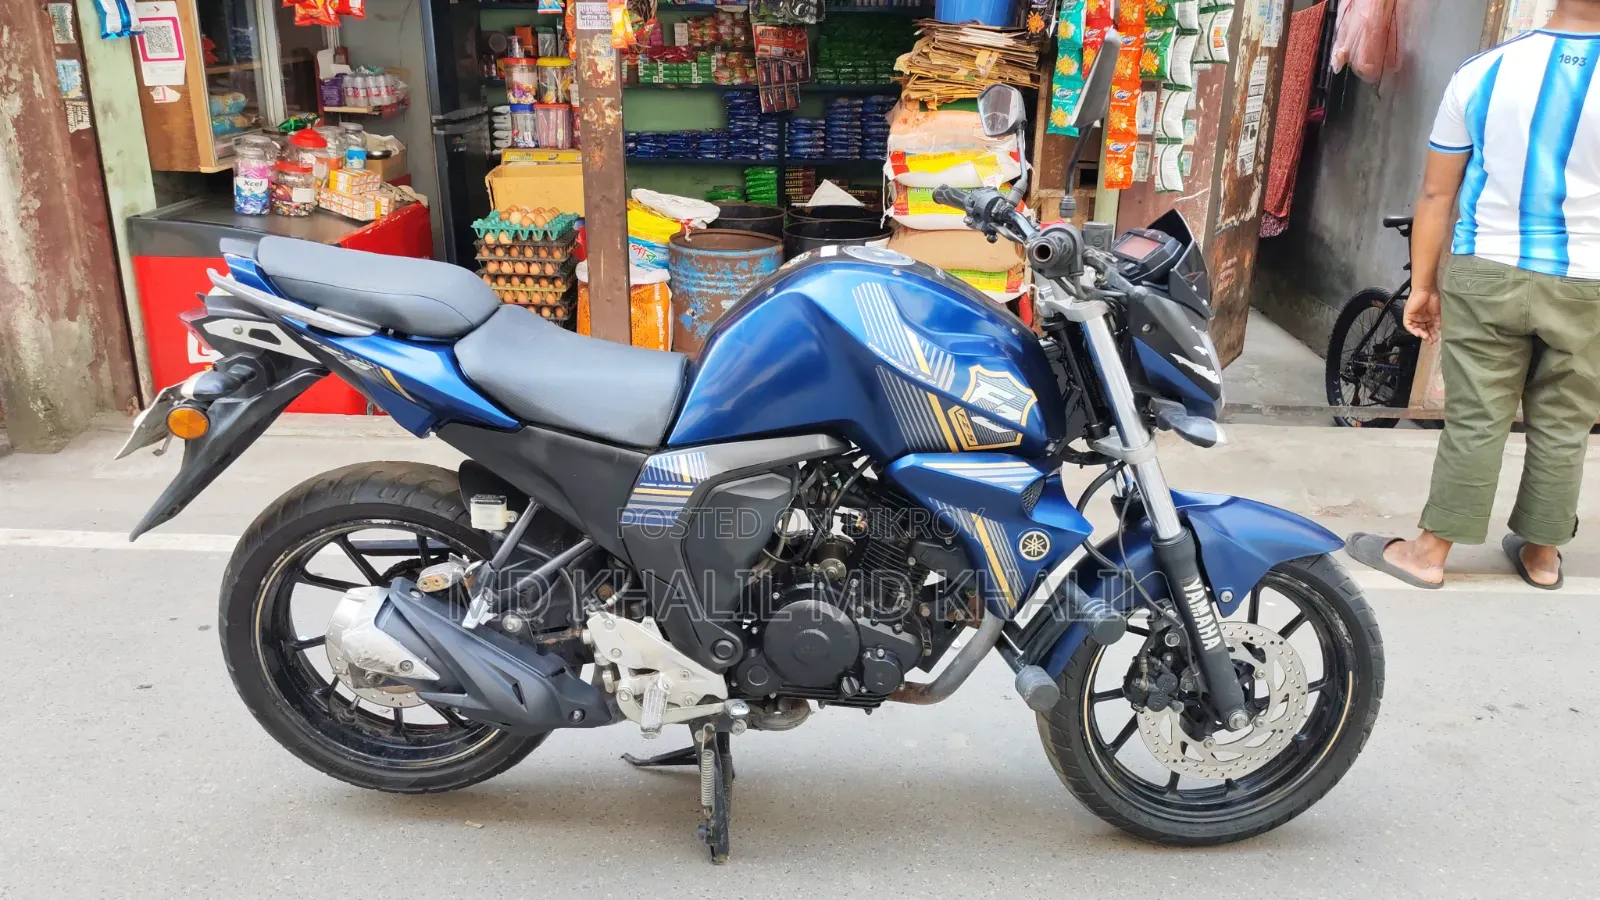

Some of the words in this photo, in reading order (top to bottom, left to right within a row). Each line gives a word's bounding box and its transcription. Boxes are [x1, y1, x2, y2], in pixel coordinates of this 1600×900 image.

[1558, 53, 1588, 67] 1893
[243, 179, 263, 187] Xcel
[1183, 576, 1221, 651] YAMAHA
